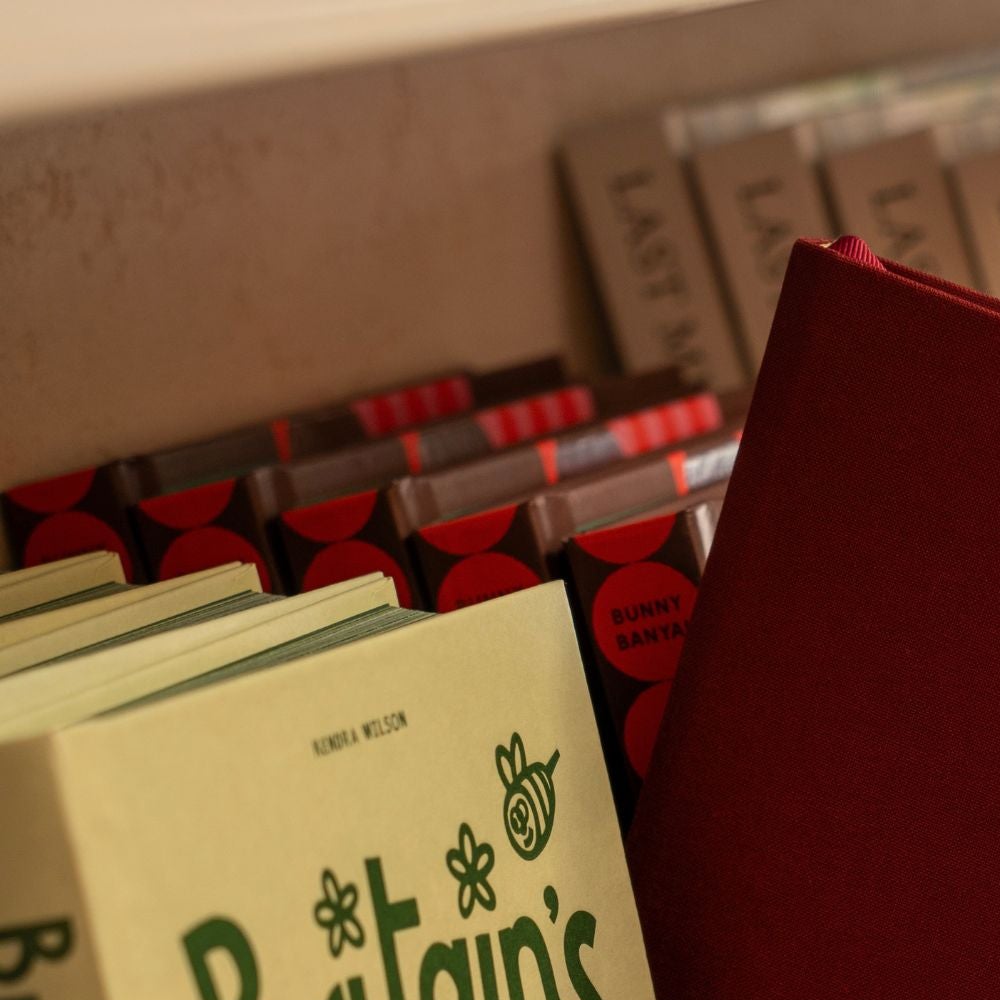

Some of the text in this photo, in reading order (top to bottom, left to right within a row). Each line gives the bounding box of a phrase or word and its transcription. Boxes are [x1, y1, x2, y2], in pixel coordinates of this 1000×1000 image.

[609, 169, 688, 298] LAST
[610, 593, 682, 626] BUNNY
[615, 619, 689, 651] BANYA
[312, 709, 408, 757] KENDRA WILSON
